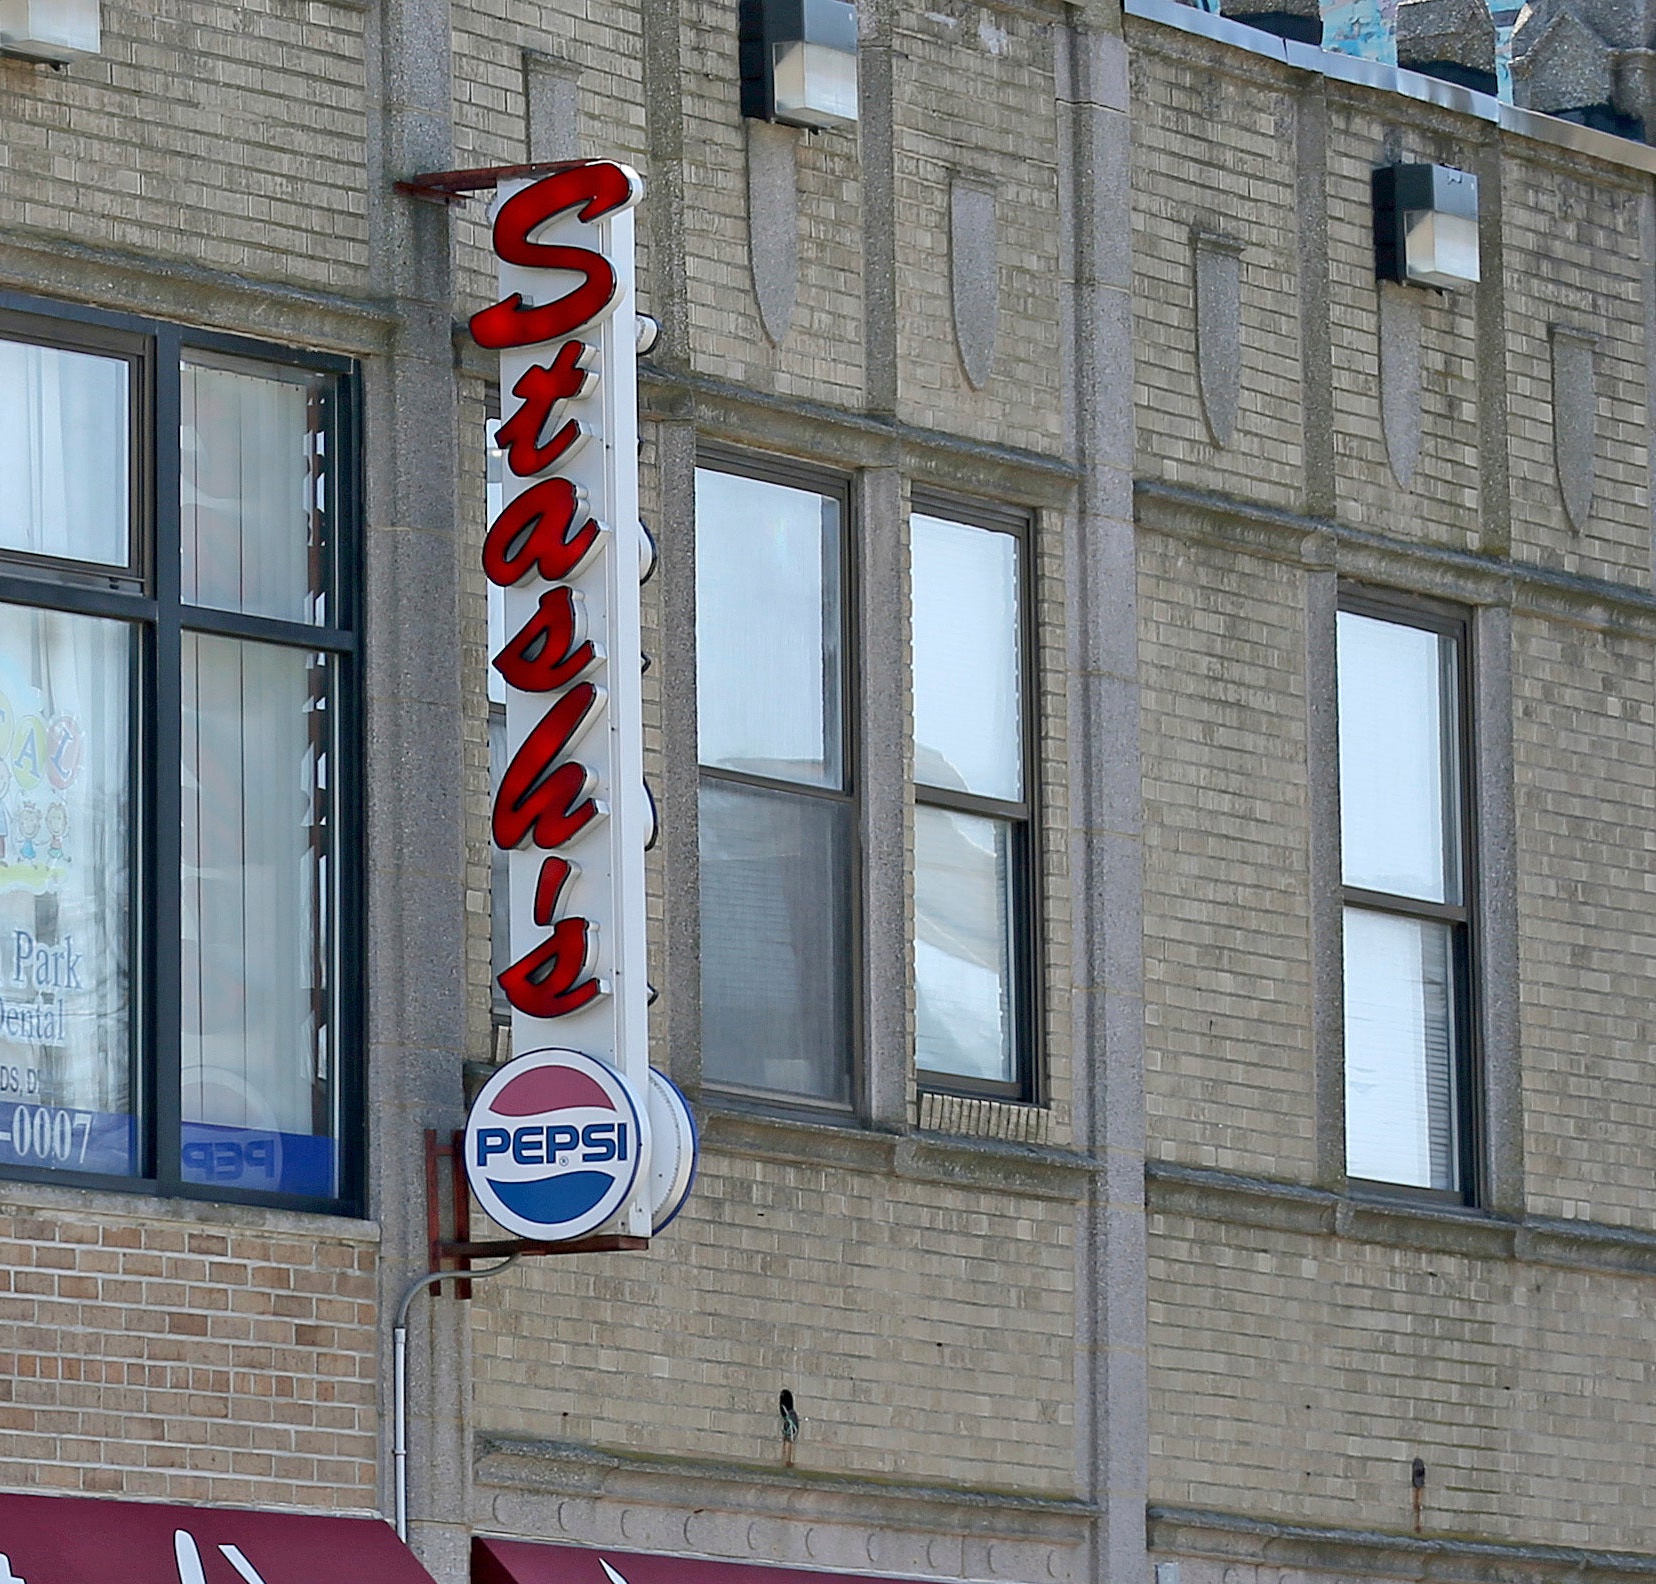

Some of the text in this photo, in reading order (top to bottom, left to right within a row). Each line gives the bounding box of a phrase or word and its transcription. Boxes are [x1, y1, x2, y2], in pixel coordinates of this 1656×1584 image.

[467, 160, 641, 1022] Stash's
[14, 929, 83, 989] Park
[477, 1122, 628, 1167] PEPSI
